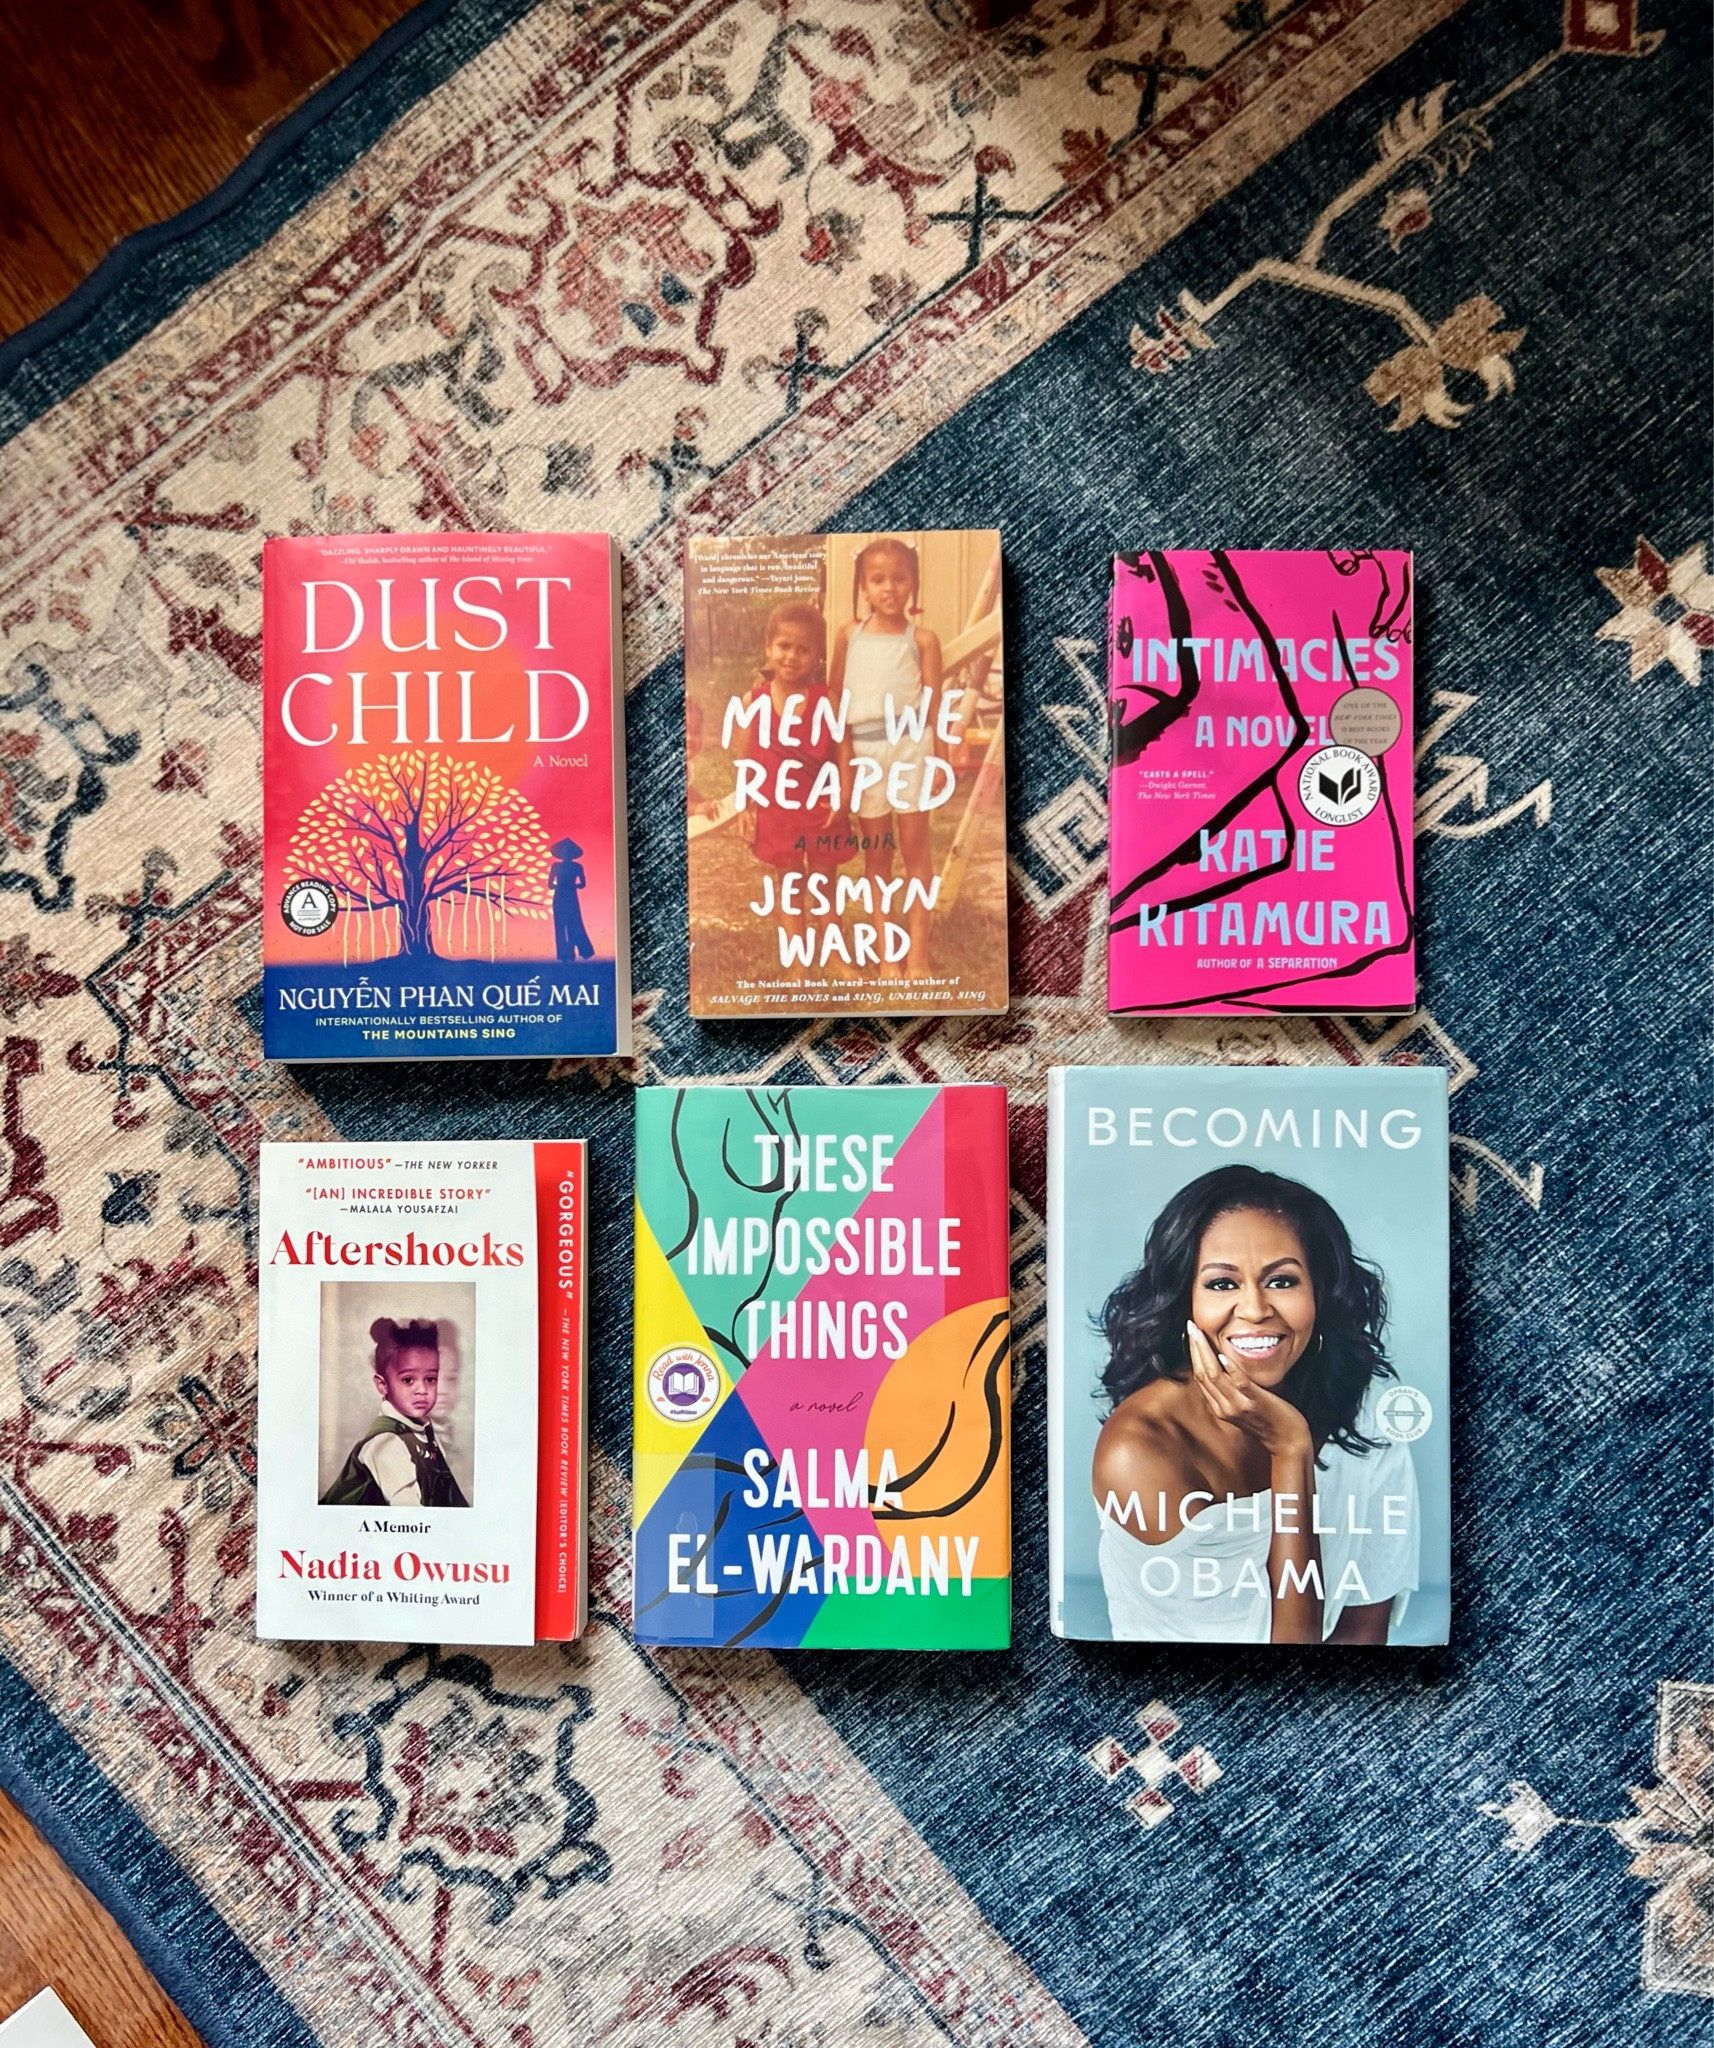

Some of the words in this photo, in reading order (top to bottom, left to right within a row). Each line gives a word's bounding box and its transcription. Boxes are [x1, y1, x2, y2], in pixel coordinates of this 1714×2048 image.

[710, 564, 742, 574] language
[743, 564, 758, 572] that
[760, 564, 766, 572] is
[784, 560, 818, 570] beautiful
[721, 552, 758, 560] chronicles
[771, 552, 808, 560] American
[702, 576, 716, 584] and
[731, 586, 748, 594] York
[750, 586, 772, 594] Times
[301, 576, 572, 653] DUST
[1132, 638, 1400, 682] INTIMACIES
[281, 670, 590, 746] CHILD
[721, 688, 851, 750] MEN
[884, 685, 965, 746] WE
[1195, 716, 1214, 748] A
[1226, 716, 1335, 748] NOVEL
[533, 755, 544, 768] A
[549, 754, 588, 768] Novel
[1138, 770, 1170, 778] "CASTS
[1172, 770, 1179, 778] A
[1302, 752, 1332, 801] NATIONAL
[1332, 749, 1364, 764] BOOK
[1361, 762, 1378, 802] AWARD
[733, 756, 956, 813] REAPED
[1137, 792, 1152, 800] The
[1154, 792, 1170, 800] New
[1174, 792, 1190, 800] York
[1192, 792, 1216, 800] Times
[1314, 807, 1364, 823] LONGLIST
[794, 834, 806, 851] A
[816, 832, 896, 852] MEMOIR
[1200, 828, 1336, 872] KATIE
[283, 884, 301, 914] ADVANCE
[300, 881, 330, 894] READING
[328, 894, 336, 912] COPY
[301, 892, 318, 908] A
[750, 872, 942, 917] JESMYN
[289, 920, 302, 932] NOT
[316, 919, 332, 932] SALE
[1139, 900, 1392, 946] KITAMURA
[778, 922, 912, 968] WARD
[1197, 958, 1238, 968] AUTHOR
[1240, 958, 1252, 968] OF
[1256, 958, 1264, 969] A
[1268, 957, 1338, 969] SEPARATION
[279, 976, 392, 1010] NGUYỄN
[400, 986, 474, 1008] PHAN
[482, 976, 541, 1010] QUẾ
[548, 984, 600, 1006] MAI
[736, 980, 756, 988] The
[758, 979, 802, 988] National
[804, 978, 828, 988] Book
[912, 976, 946, 986] author
[948, 976, 960, 986] of
[710, 994, 760, 1006] SALVAGE
[764, 994, 788, 1003] THE
[790, 994, 830, 1002] BONES
[832, 992, 850, 1002] and
[853, 992, 885, 1004] SING,
[888, 991, 954, 1000] UNBURIED,
[956, 991, 986, 1002] SING
[315, 1016, 416, 1026] INTERNATIONALLY
[420, 1015, 495, 1024] BESTSELLING
[498, 1014, 544, 1024] AUTHOR
[546, 1014, 563, 1024] OF
[362, 1030, 390, 1040] THE
[394, 1029, 478, 1040] MOUNTAINS
[482, 1028, 516, 1038] SING
[1088, 1107, 1422, 1150] BECOMING
[298, 1158, 392, 1170] "AMBITIOUS"
[428, 1160, 453, 1170] NEW
[457, 1160, 499, 1170] YORKER
[754, 1134, 894, 1192] THESE
[306, 1187, 346, 1200] "[AN]
[352, 1188, 433, 1200] INCREDIBLE
[440, 1188, 492, 1200] STORY"
[396, 1204, 458, 1214] YOUSAFZAI
[268, 1230, 524, 1266] Aftershocks
[558, 1170, 574, 1300] "GORGEOUS"
[688, 1218, 961, 1276] IMPOSSIBLE
[744, 1300, 908, 1360] THINGS
[561, 1338, 570, 1362] NEW
[561, 1365, 570, 1392] YORK
[652, 1354, 674, 1381] Read
[676, 1352, 694, 1362] with
[694, 1354, 714, 1382] Jenna
[561, 1395, 570, 1424] TIMES
[790, 1402, 804, 1412] a
[808, 1391, 864, 1413] novel
[560, 1427, 569, 1456] BOOK
[1406, 1428, 1422, 1438] CLUB
[560, 1460, 568, 1497] REVIEW
[742, 1448, 904, 1508] SALMA
[358, 1520, 370, 1532] A
[374, 1520, 432, 1534] Memoir
[1100, 1490, 1408, 1536] MICHELLE
[277, 1550, 382, 1580] Nadia
[393, 1552, 510, 1584] Owusu
[557, 1552, 568, 1593] CHOICE)
[668, 1534, 980, 1596] EL-WARDANY
[1139, 1556, 1371, 1600] OBAMA
[308, 1590, 358, 1602] Winner
[361, 1591, 374, 1602] of
[376, 1594, 384, 1602] a
[386, 1592, 439, 1607] Whiting
[440, 1594, 480, 1605] Award
